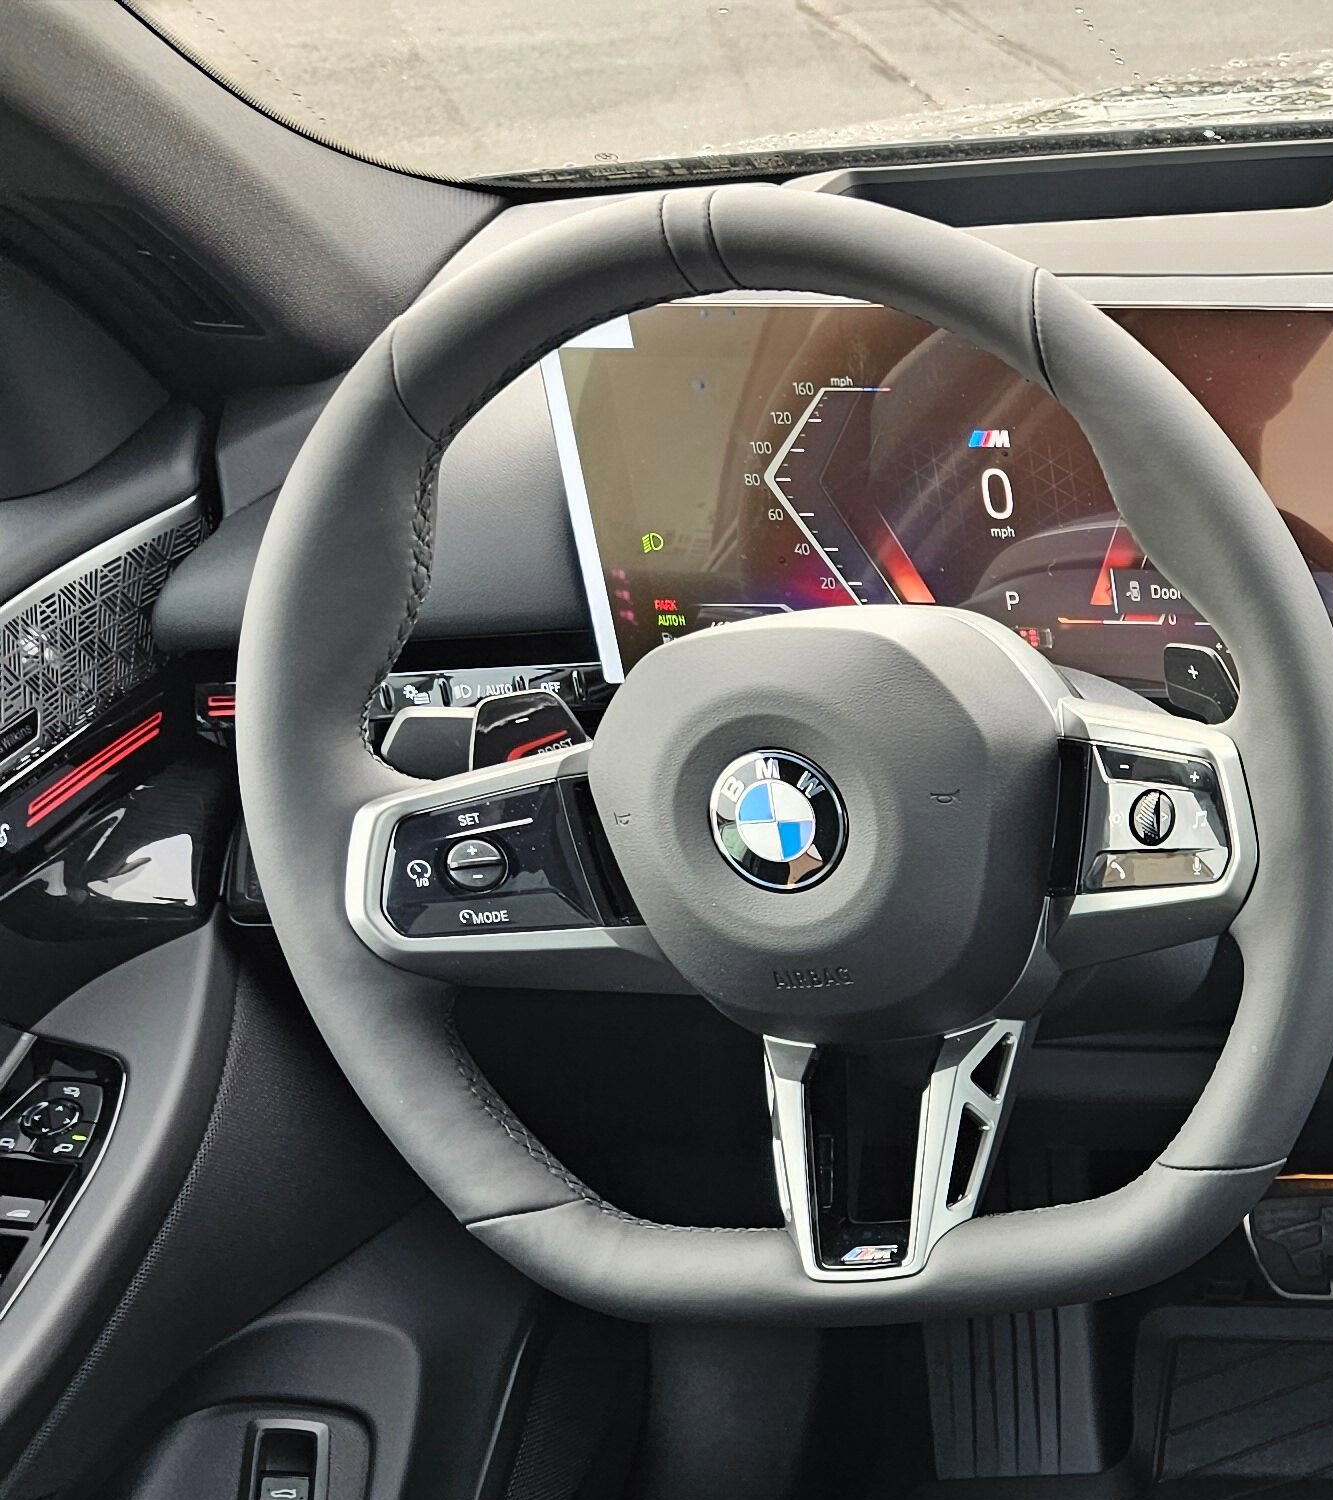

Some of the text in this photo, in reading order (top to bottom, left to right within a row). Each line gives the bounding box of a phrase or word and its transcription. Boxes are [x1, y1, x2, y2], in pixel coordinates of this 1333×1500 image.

[830, 376, 853, 387] mph
[792, 382, 814, 395] 160
[770, 411, 792, 424] 120
[749, 441, 772, 454] 100
[744, 473, 760, 486] 80
[981, 468, 1014, 520] 0
[768, 508, 784, 520] 60
[990, 526, 1015, 539] mph
[794, 543, 810, 555] 40
[820, 577, 836, 589] 20
[654, 599, 678, 611] PARK
[1005, 591, 1020, 611] P
[658, 614, 679, 627] AUTO
[485, 683, 513, 697] AUTO
[540, 681, 561, 693] OFF
[720, 757, 826, 802] BMW
[457, 812, 480, 827] SET
[472, 910, 510, 925] MODE
